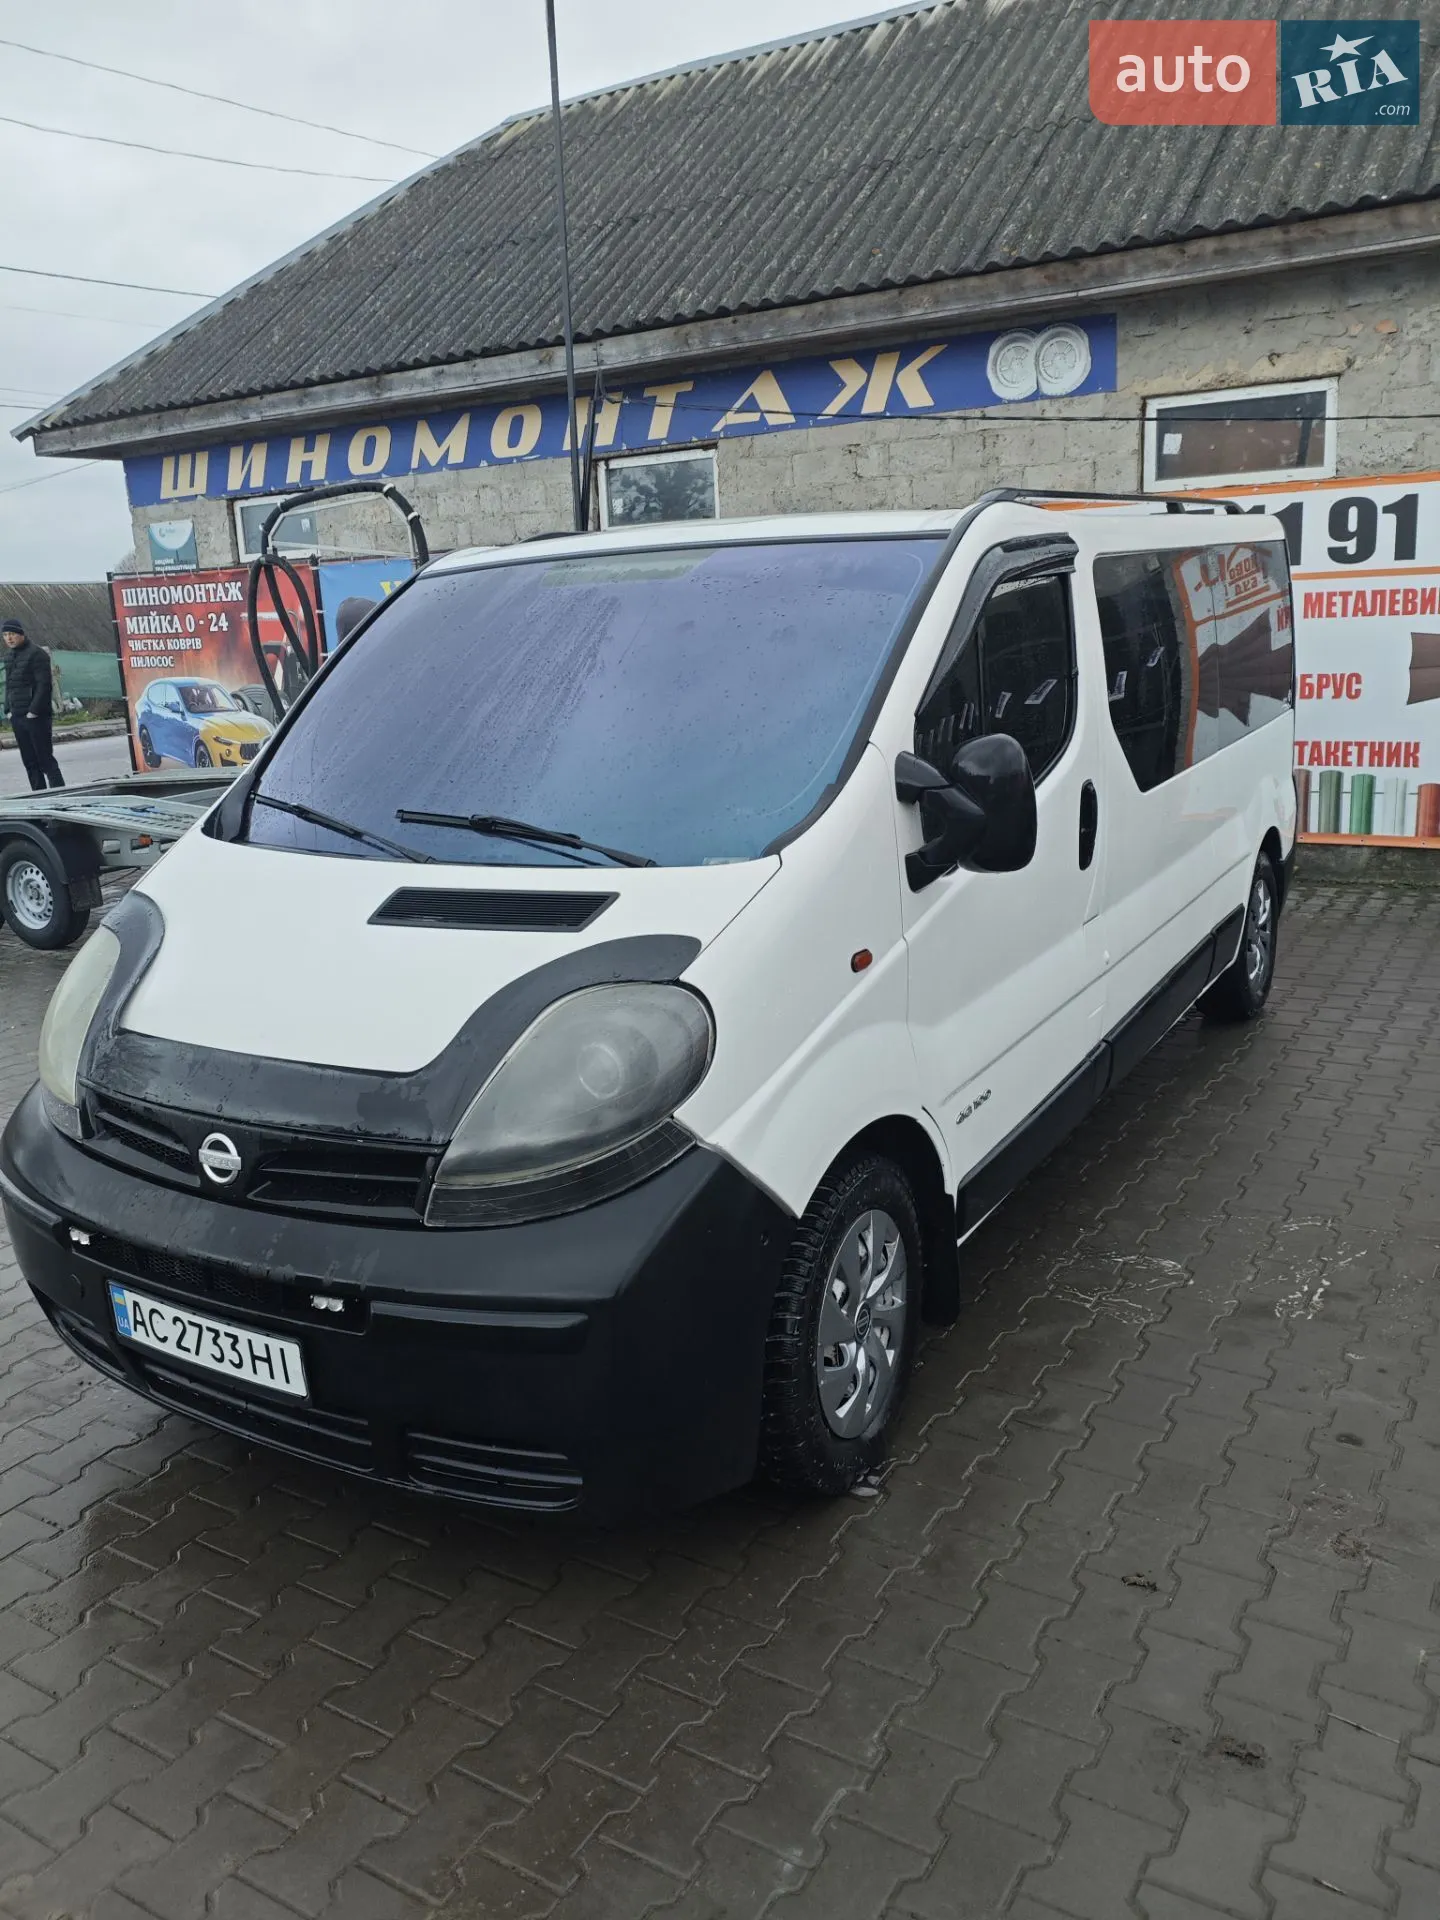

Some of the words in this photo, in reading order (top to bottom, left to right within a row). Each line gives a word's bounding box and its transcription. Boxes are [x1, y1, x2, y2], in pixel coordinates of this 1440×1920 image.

[160, 343, 948, 499] ШИНОМОНТАЖ
[121, 581, 244, 607] ШИНОМОНТАЖ
[1303, 587, 1440, 619] МЕТАЛЕВИ
[125, 610, 183, 635] МИЙКА
[207, 612, 229, 632] 24
[128, 639, 166, 652] ЧИСТКА
[167, 637, 203, 651] КОВРІВ
[130, 655, 175, 669] ПИЛОСОС
[117, 1316, 130, 1330] UA
